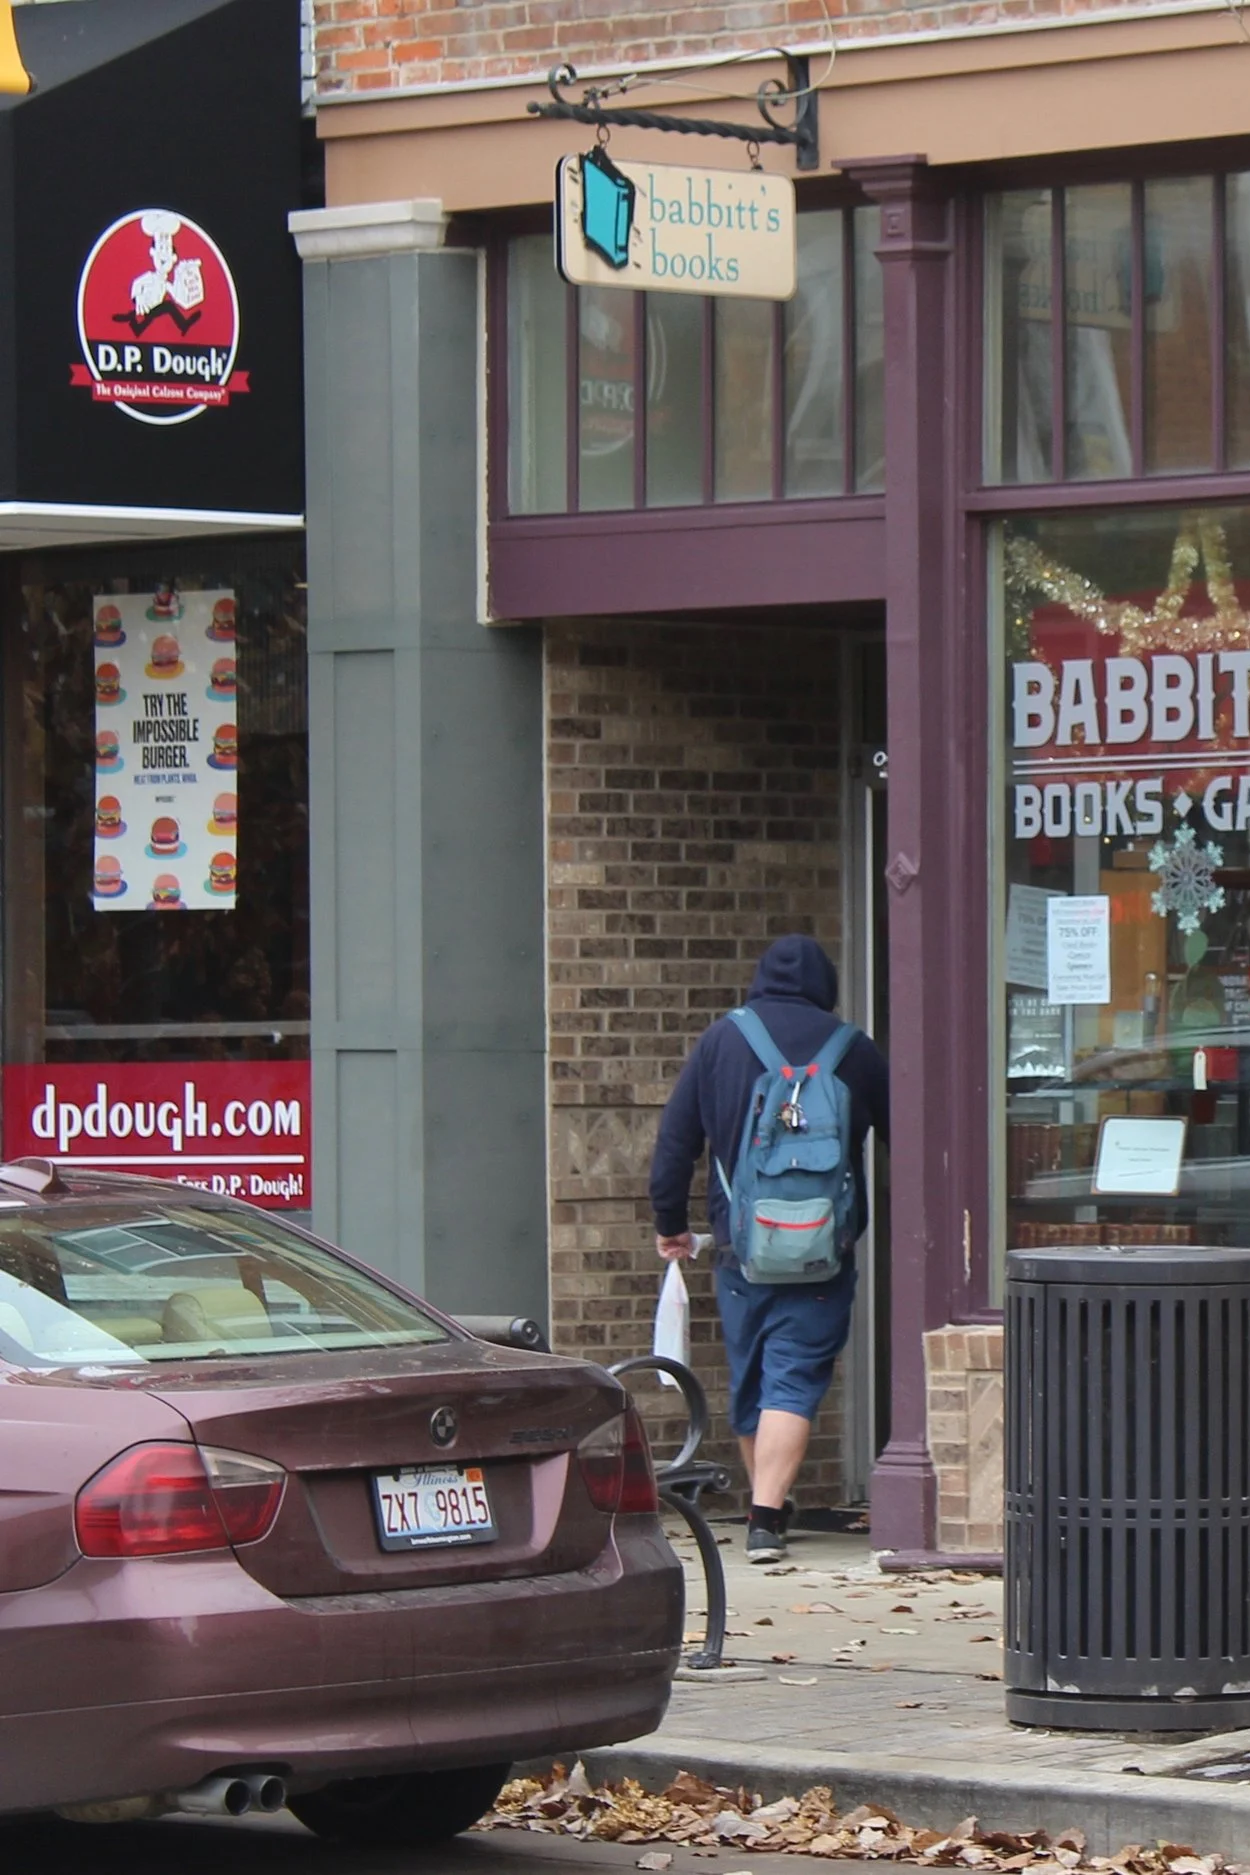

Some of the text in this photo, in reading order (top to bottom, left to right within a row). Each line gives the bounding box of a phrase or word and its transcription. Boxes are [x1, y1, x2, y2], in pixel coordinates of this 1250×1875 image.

[648, 173, 781, 232] babbitt's
[650, 228, 739, 282] books
[97, 344, 143, 373] D.P.
[96, 383, 223, 402] The Original Calzone Company
[142, 692, 188, 718] TRY THE
[132, 718, 199, 744] IMPOSSIBLE
[142, 745, 190, 770] BURGER.
[1014, 777, 1164, 839] BOOKS
[1058, 926, 1078, 938] 75%
[212, 1174, 246, 1196] D.P.
[250, 1173, 304, 1200] Dough!
[405, 1472, 459, 1488] Illinois
[382, 1485, 490, 1533] ZX7 9815
